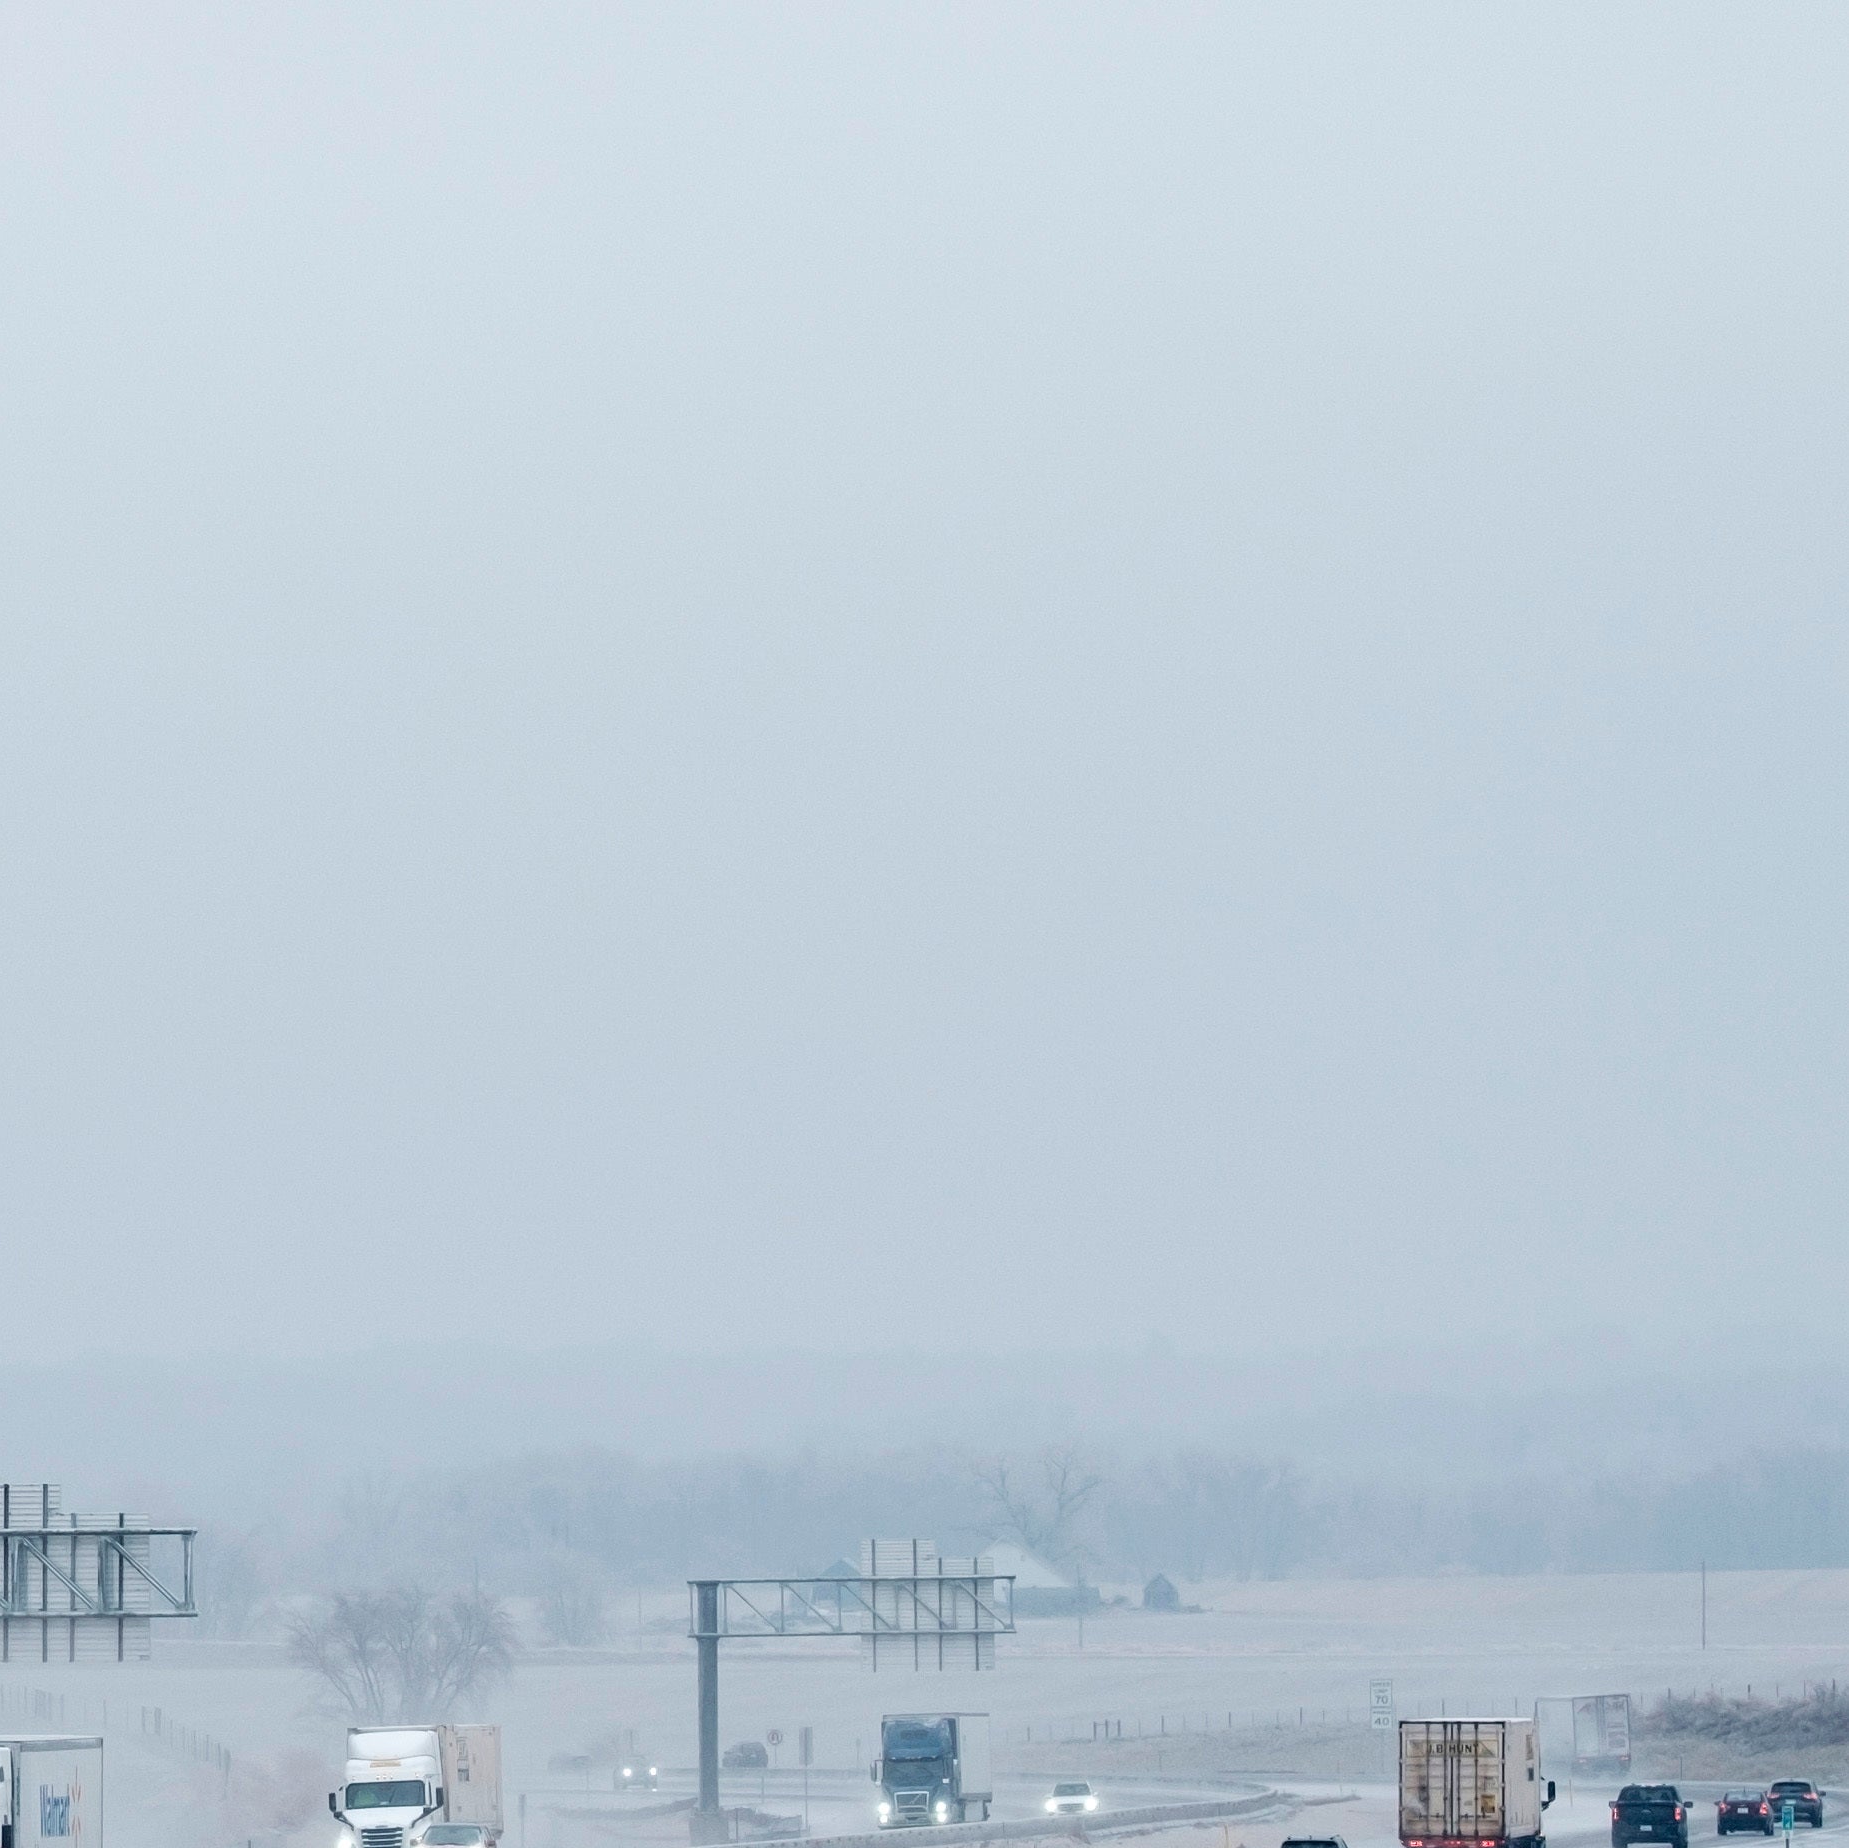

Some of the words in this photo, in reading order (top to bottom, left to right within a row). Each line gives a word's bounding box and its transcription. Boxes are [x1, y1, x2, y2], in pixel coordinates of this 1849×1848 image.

[1375, 1695, 1389, 1704] 70
[1374, 1717, 1389, 1726] 40
[39, 1783, 71, 1838] Walmart
